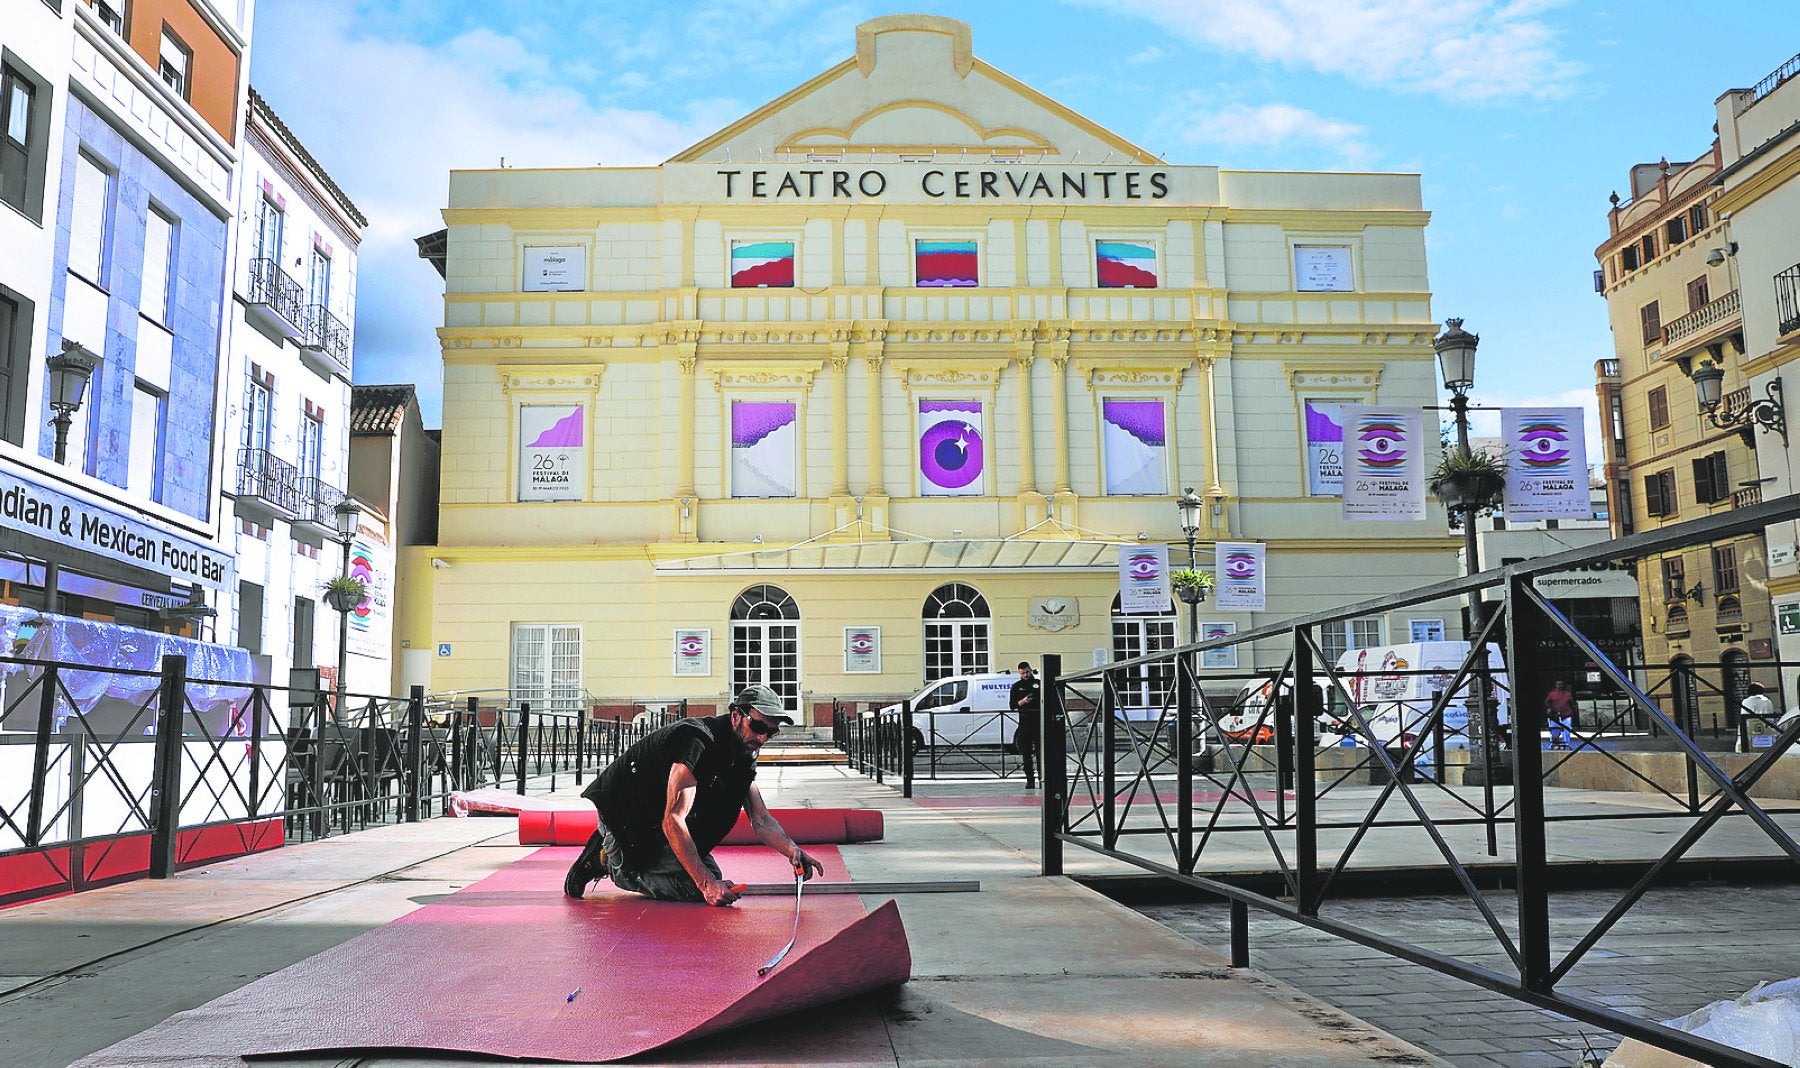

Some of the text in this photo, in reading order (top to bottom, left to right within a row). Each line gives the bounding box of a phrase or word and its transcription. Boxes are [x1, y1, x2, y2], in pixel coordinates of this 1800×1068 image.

[717, 170, 1168, 199] TEATRO CERVANTES
[533, 454, 554, 469] 26
[1319, 449, 1339, 464] 26
[1356, 481, 1368, 491] 26
[1520, 480, 1533, 491] 26
[0, 486, 225, 584] dian & Mexican Food Bar
[1537, 577, 1602, 587] supermercados
